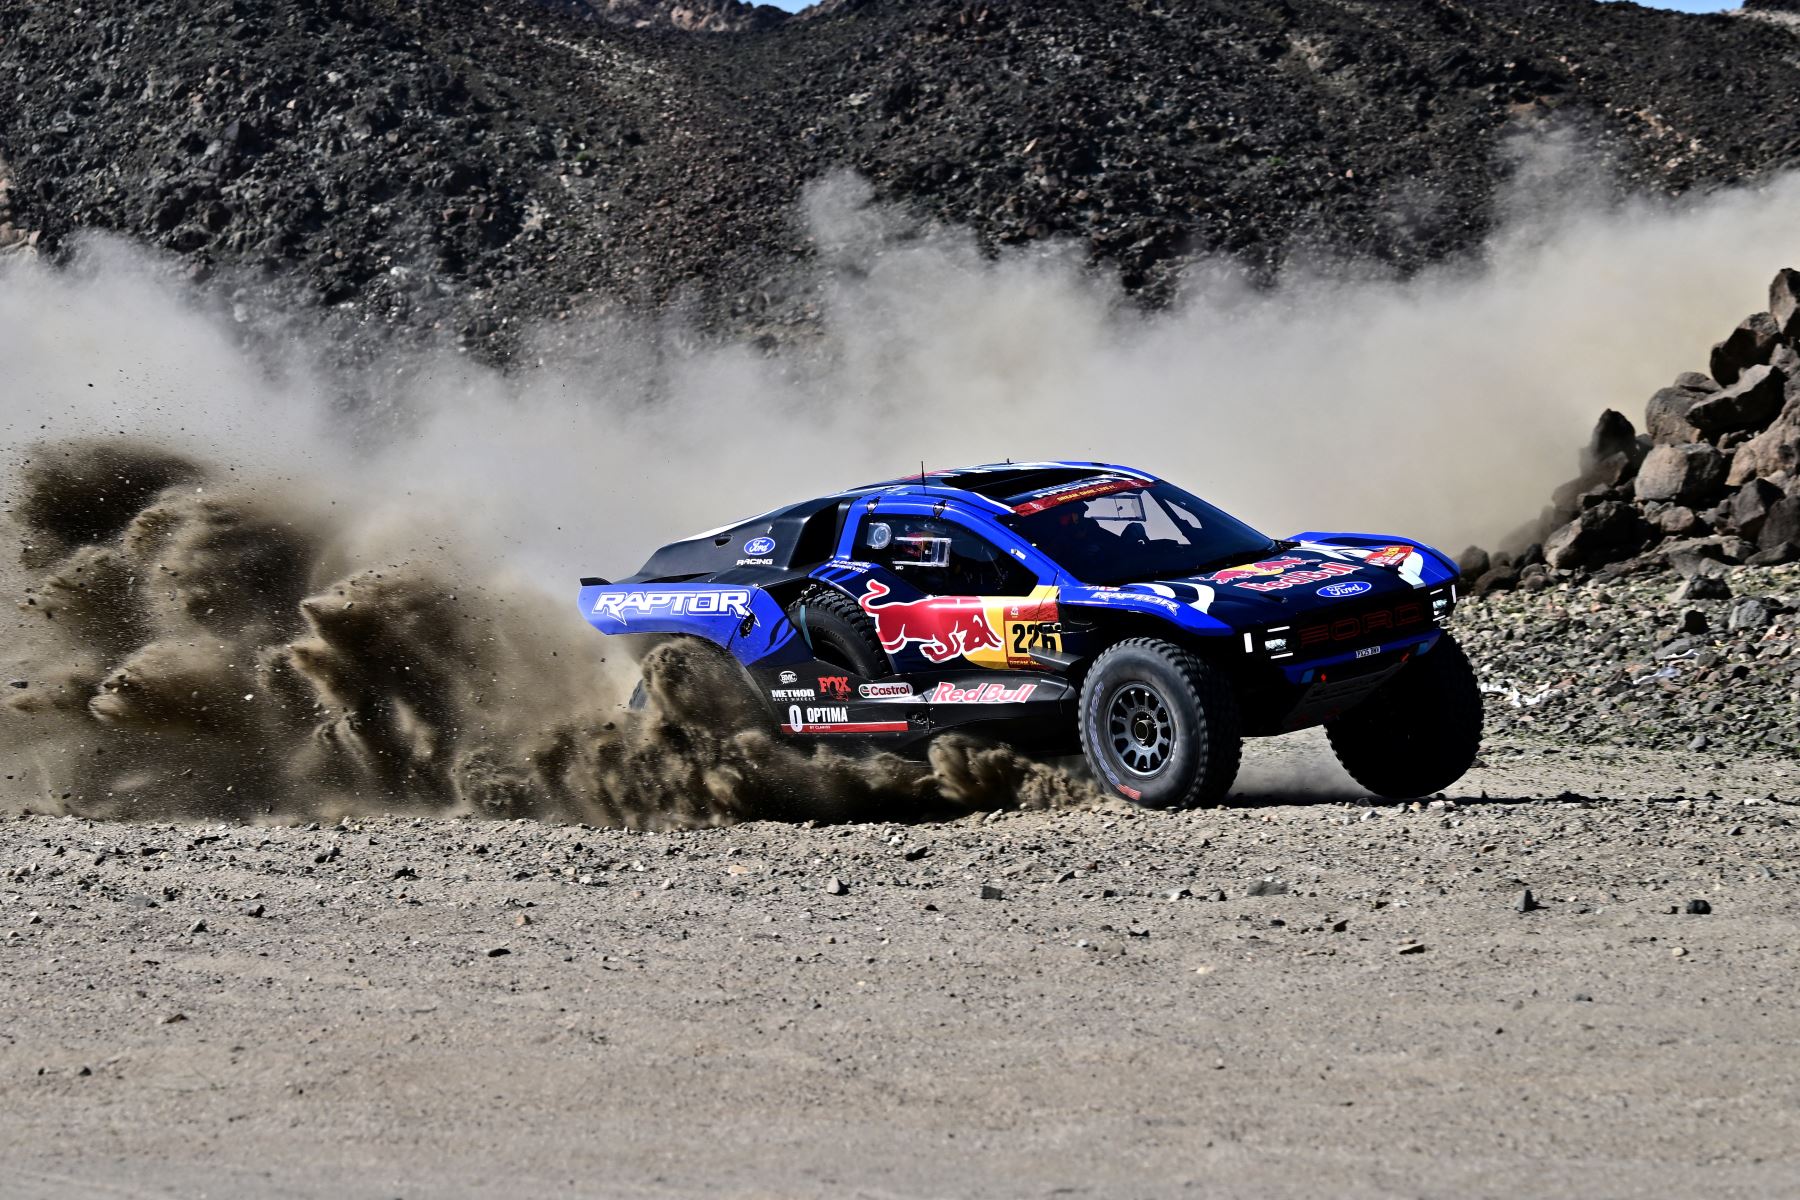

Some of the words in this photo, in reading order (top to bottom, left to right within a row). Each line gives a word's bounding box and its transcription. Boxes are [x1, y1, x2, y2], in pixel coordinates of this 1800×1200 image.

[747, 539, 771, 553] Ford
[736, 558, 773, 566] RACING
[1233, 575, 1313, 592] Red
[1285, 562, 1364, 581] Bull
[1325, 582, 1364, 596] Ford
[592, 590, 760, 627] RAPTOR
[1090, 592, 1180, 616] RAPTOR
[1297, 602, 1425, 648] FORD
[771, 689, 815, 698] METHOD
[818, 677, 851, 694] FOX
[871, 684, 910, 696] Castrol
[931, 682, 987, 702] Red
[980, 684, 1037, 703] Bull
[806, 707, 848, 723] OPTIMA
